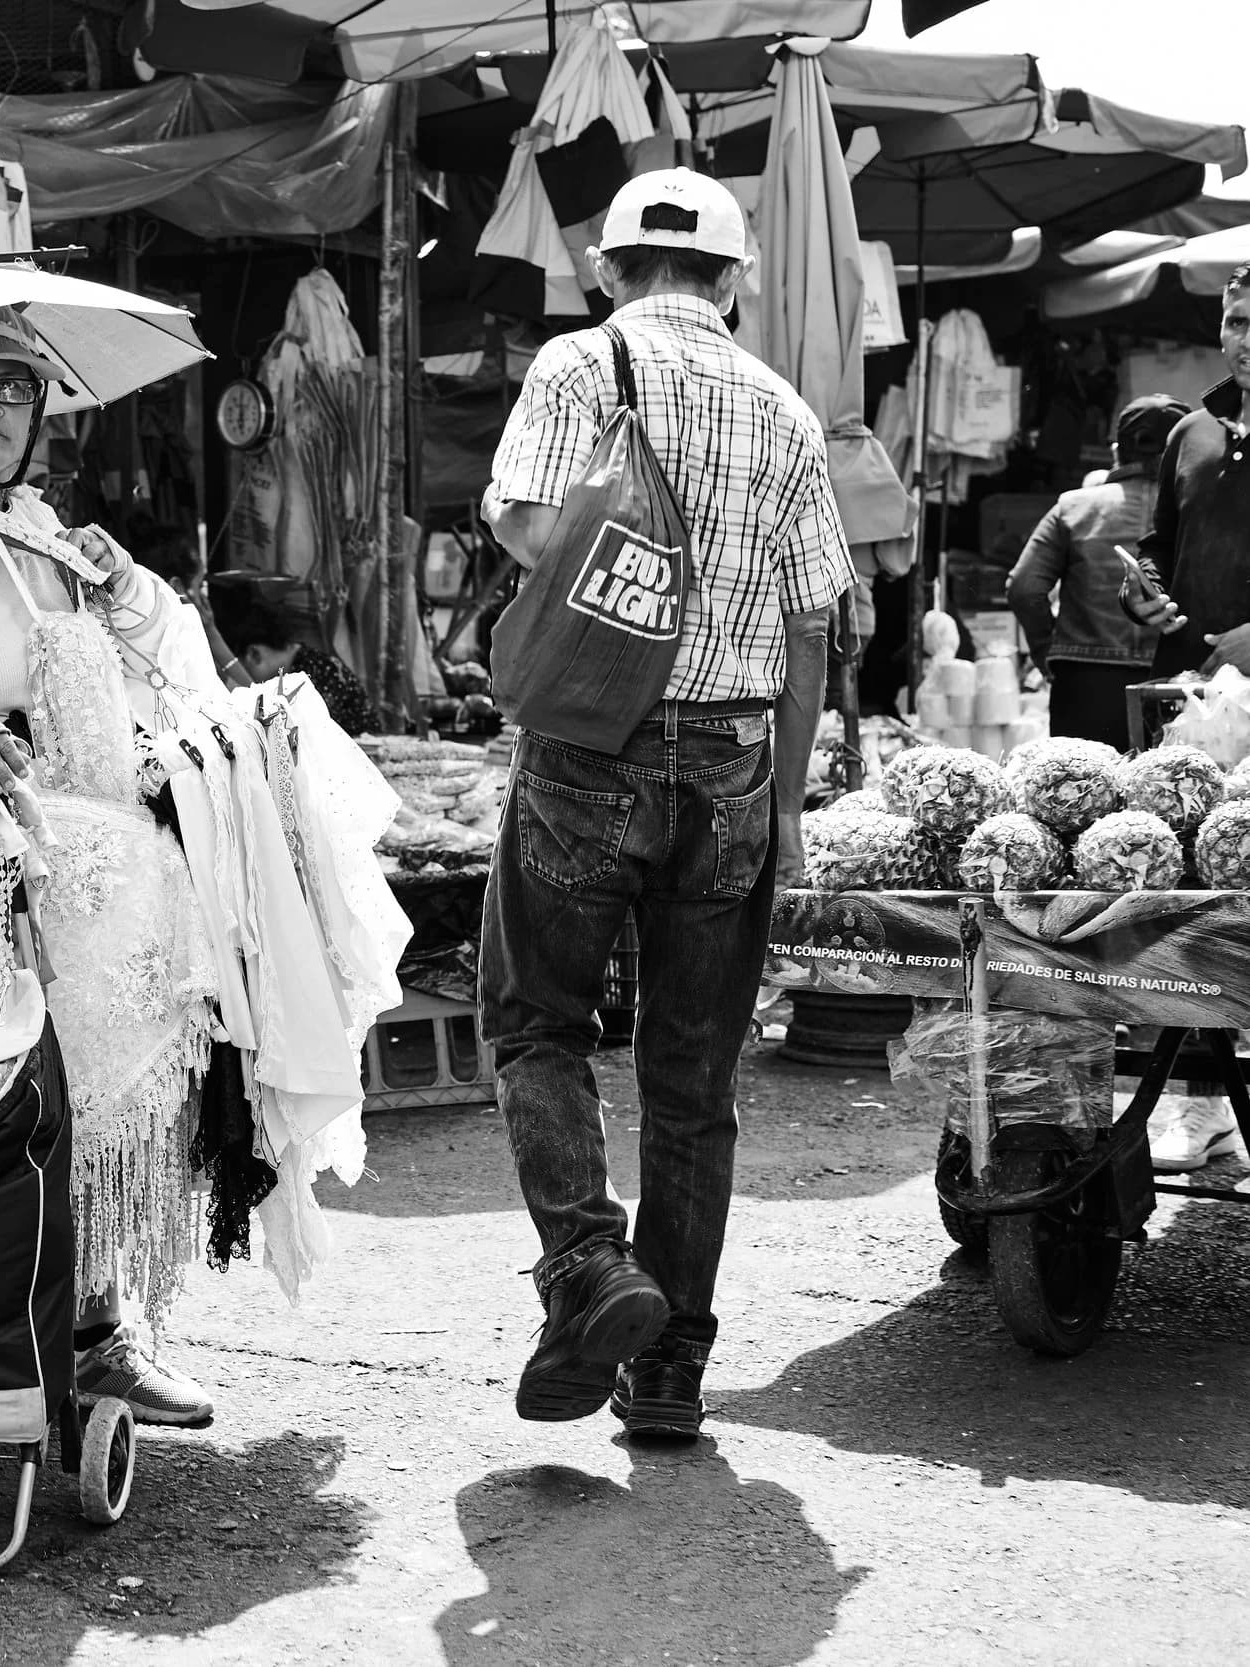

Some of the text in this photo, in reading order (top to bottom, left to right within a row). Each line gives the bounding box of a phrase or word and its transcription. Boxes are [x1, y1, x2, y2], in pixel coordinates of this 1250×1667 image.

[611, 541, 672, 593] BUD
[581, 569, 678, 630] LIGHT
[793, 945, 885, 965] COMPARACIÓN
[887, 954, 904, 965] AL
[906, 955, 949, 968] RESTO
[1055, 968, 1071, 981] DE
[1074, 972, 1138, 989] SALSITAS
